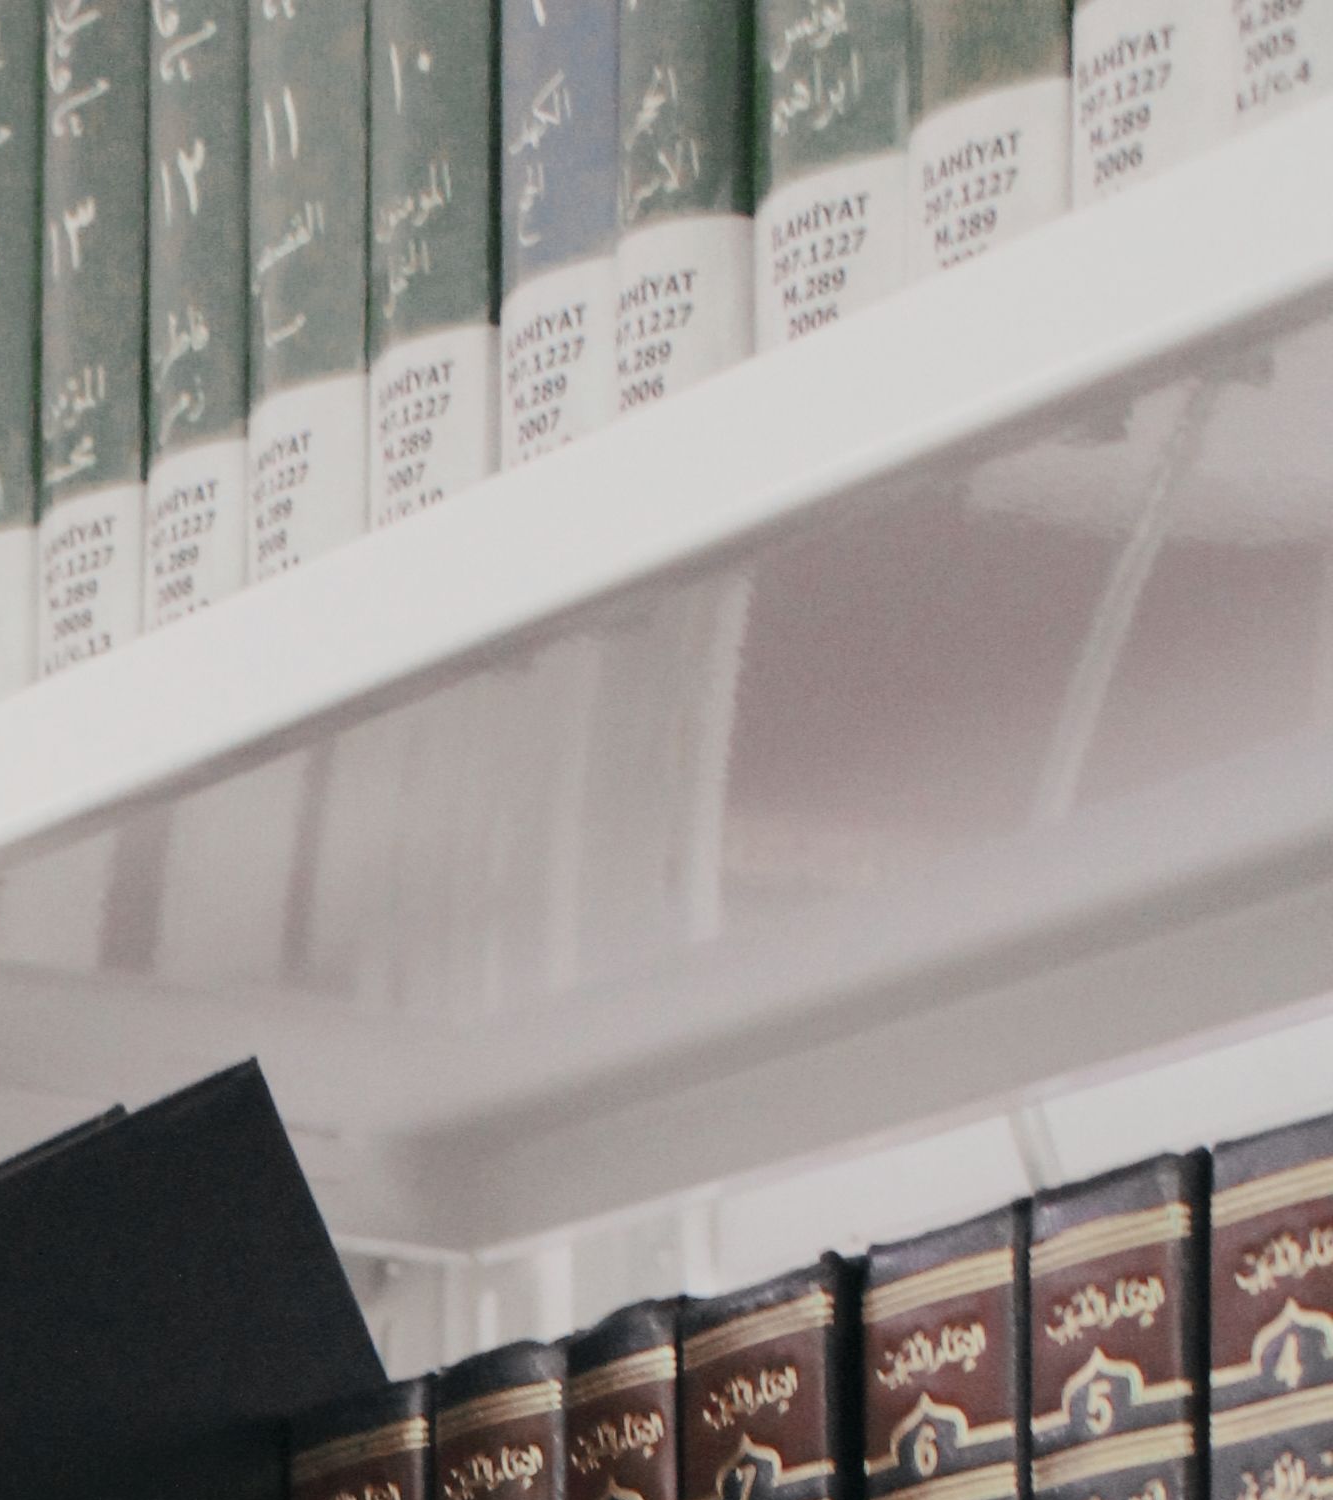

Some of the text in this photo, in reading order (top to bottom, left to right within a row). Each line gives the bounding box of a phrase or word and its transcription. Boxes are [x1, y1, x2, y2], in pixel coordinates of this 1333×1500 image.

[390, 42, 431, 114] ١٠
[263, 86, 299, 168] ١١
[161, 138, 206, 226] ١٢
[49, 196, 96, 280] ١٣
[935, 207, 997, 252] M.289
[783, 267, 846, 309] M.289
[1275, 1333, 1303, 1389] 4
[1086, 1378, 1113, 1435] 5
[913, 1423, 939, 1477] 6
